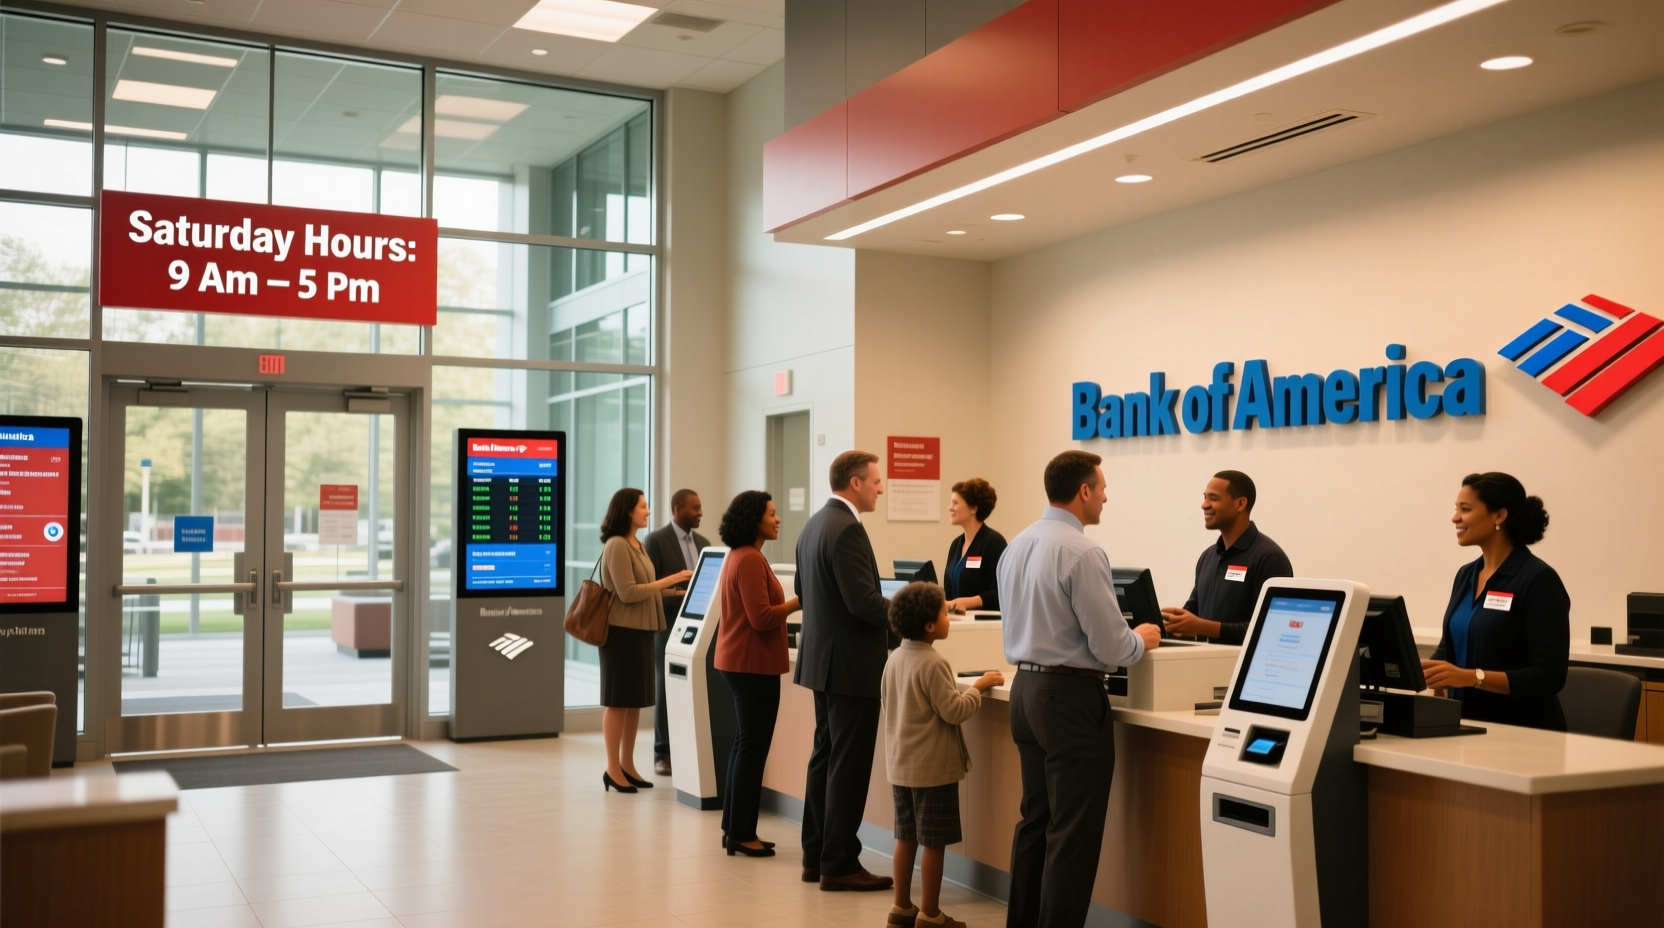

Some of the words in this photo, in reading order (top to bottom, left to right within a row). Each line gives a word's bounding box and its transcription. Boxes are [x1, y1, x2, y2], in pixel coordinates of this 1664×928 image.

[128, 209, 295, 262] Saturday
[304, 223, 417, 263] Hours:
[168, 259, 190, 291] 9
[197, 261, 258, 296] Am
[297, 268, 317, 300] 5
[327, 271, 380, 303] Pm
[1072, 371, 1181, 441] Bank
[1181, 361, 1235, 434] of
[1233, 343, 1487, 430] America
